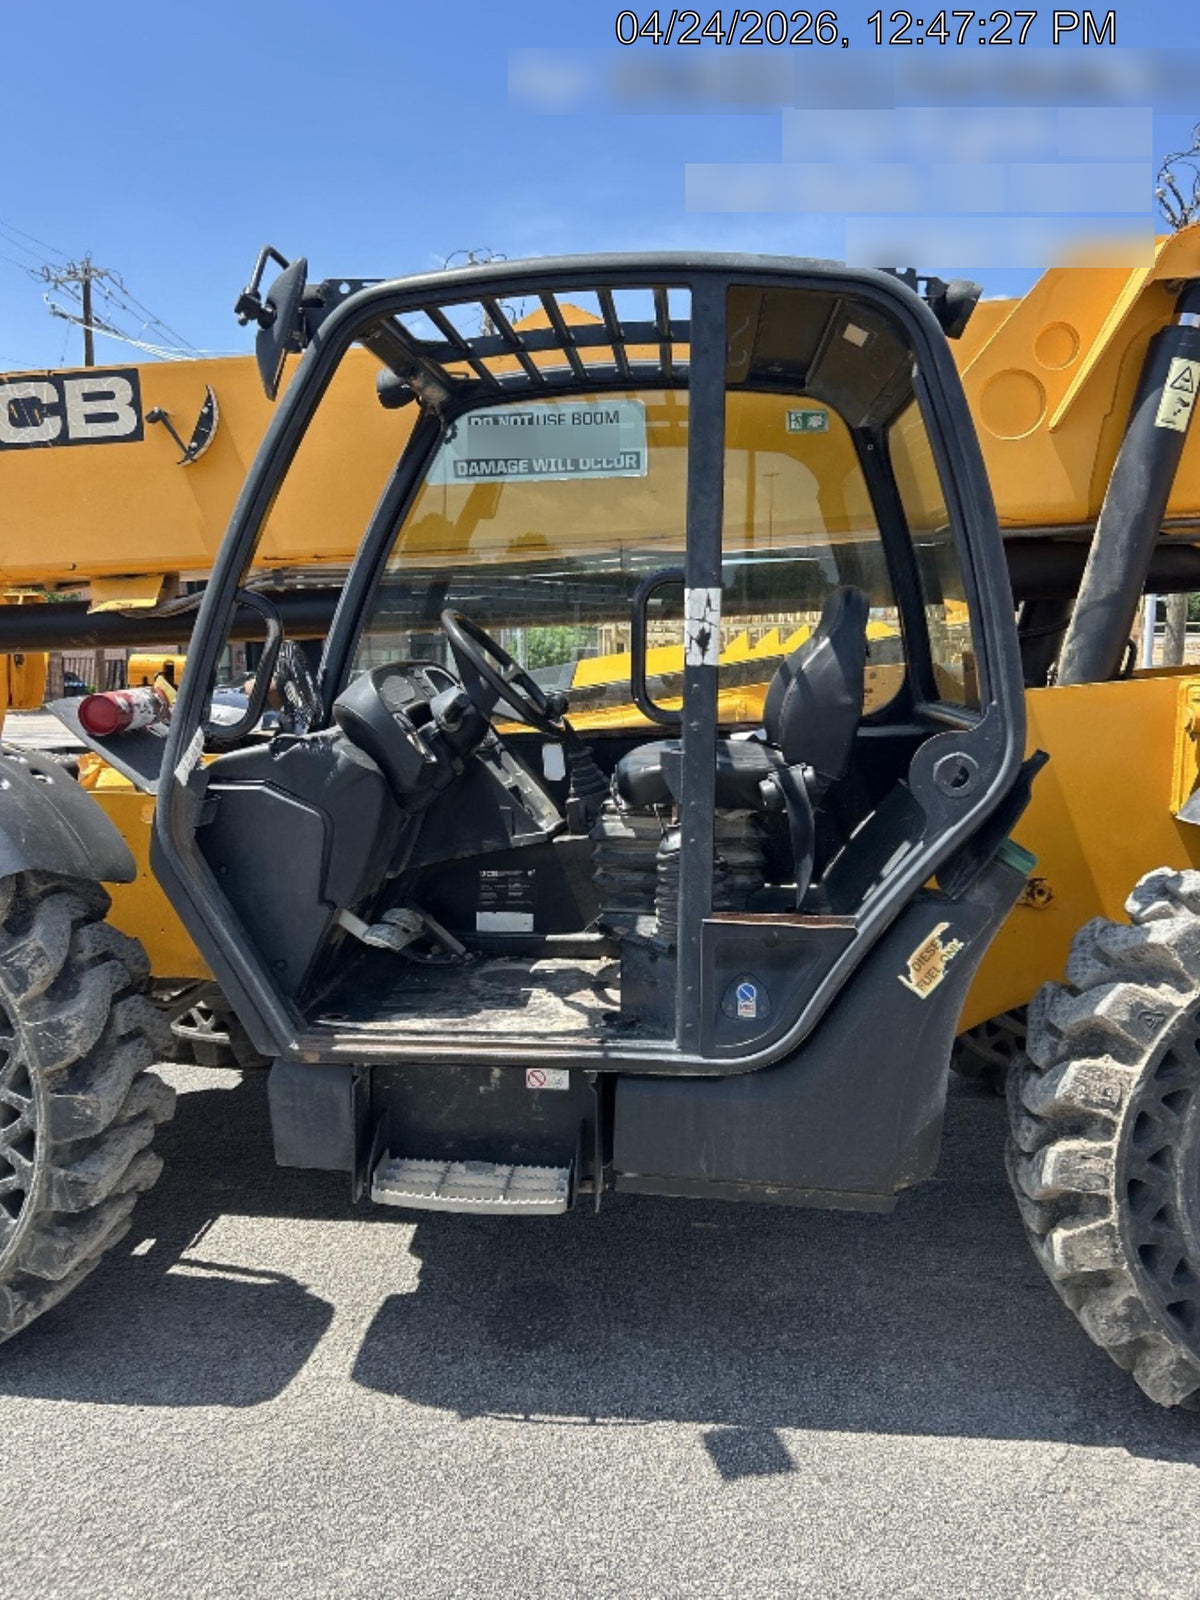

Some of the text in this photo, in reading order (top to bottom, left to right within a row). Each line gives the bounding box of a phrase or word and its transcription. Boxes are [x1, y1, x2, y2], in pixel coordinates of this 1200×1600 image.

[499, 414, 533, 426] NOT
[536, 413, 566, 426] USE
[572, 410, 619, 425] BOOM
[457, 453, 638, 476] DAMAGE WILL OCCUR
[911, 939, 940, 973] DIESE
[915, 966, 941, 991] FUEL
